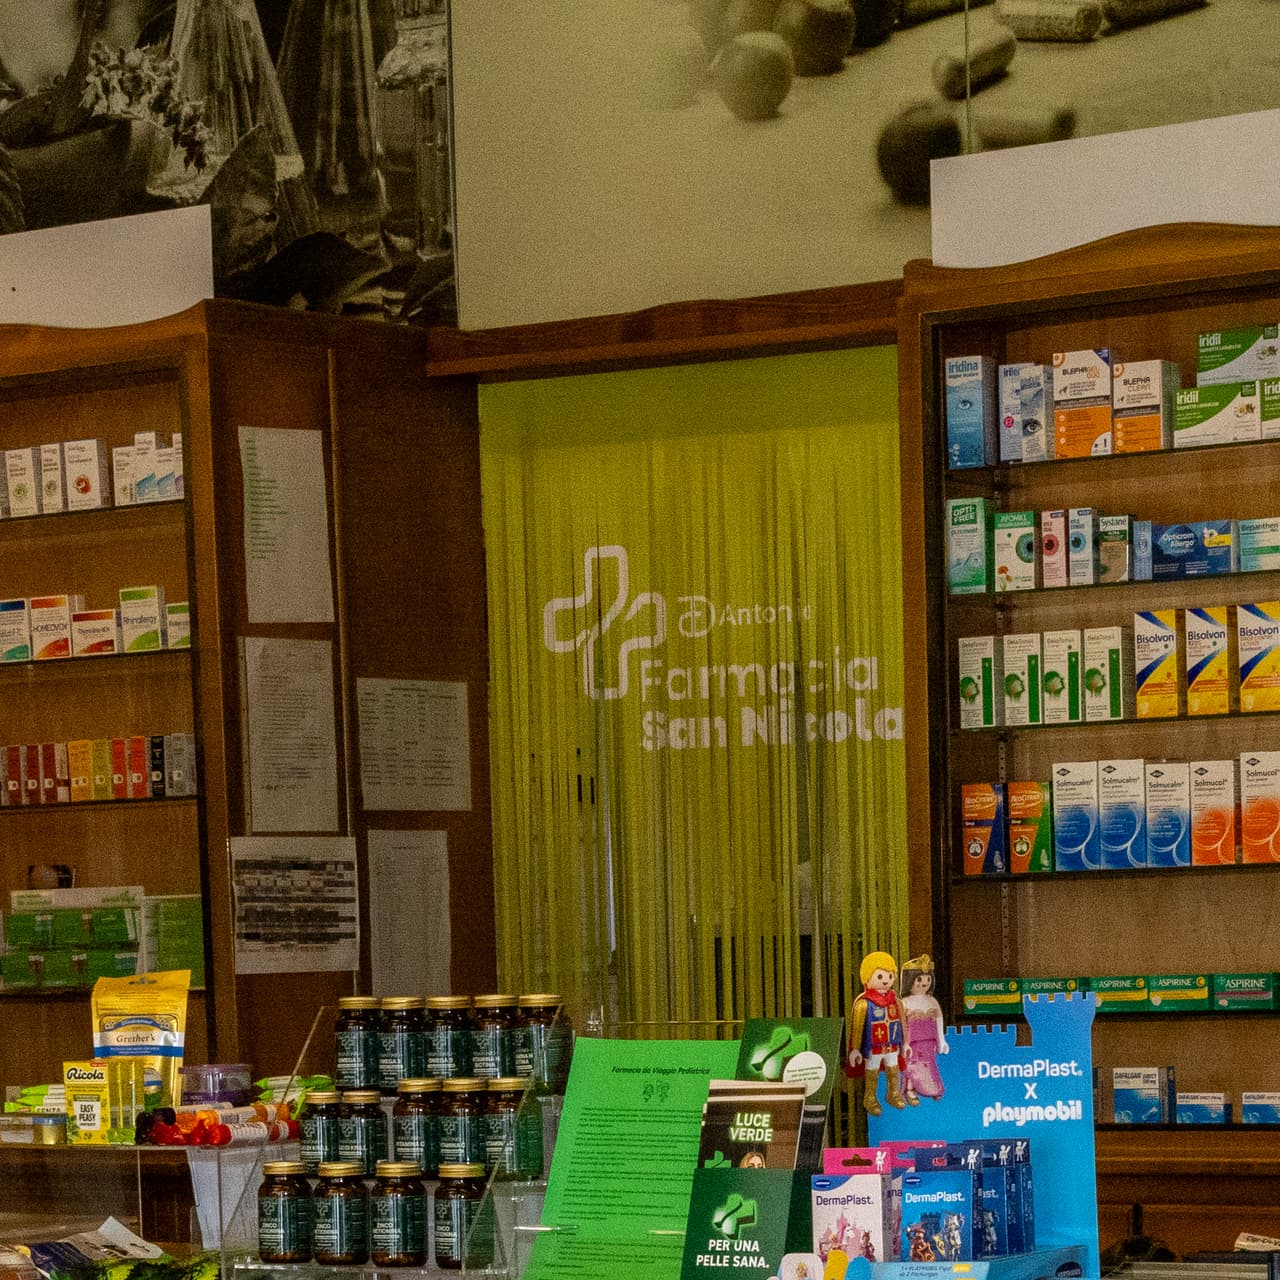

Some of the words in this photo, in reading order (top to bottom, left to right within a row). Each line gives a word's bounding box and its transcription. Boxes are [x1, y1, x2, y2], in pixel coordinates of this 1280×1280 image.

[948, 361, 978, 374] iridina
[1136, 634, 1175, 645] Bisolvon
[640, 646, 878, 702] Farmacia
[642, 709, 728, 751] San
[740, 697, 904, 748] Nicola
[1224, 978, 1266, 989] ASPIRINE
[116, 1034, 156, 1044] Grether's
[67, 1067, 105, 1081] Ricola
[978, 1059, 1078, 1079] DermaPlast
[80, 1104, 94, 1113] EASY
[982, 1101, 1082, 1127] playmobil
[79, 1113, 96, 1122] PEASY
[735, 1113, 770, 1128] LUCE
[730, 1127, 773, 1142] VERDE
[816, 1194, 871, 1207] DermaPlast
[906, 1191, 962, 1203] DermaPlast
[709, 1240, 730, 1252] PER
[734, 1241, 760, 1252] UNA
[696, 1255, 729, 1268] PELLE
[733, 1255, 770, 1269] SANA.
